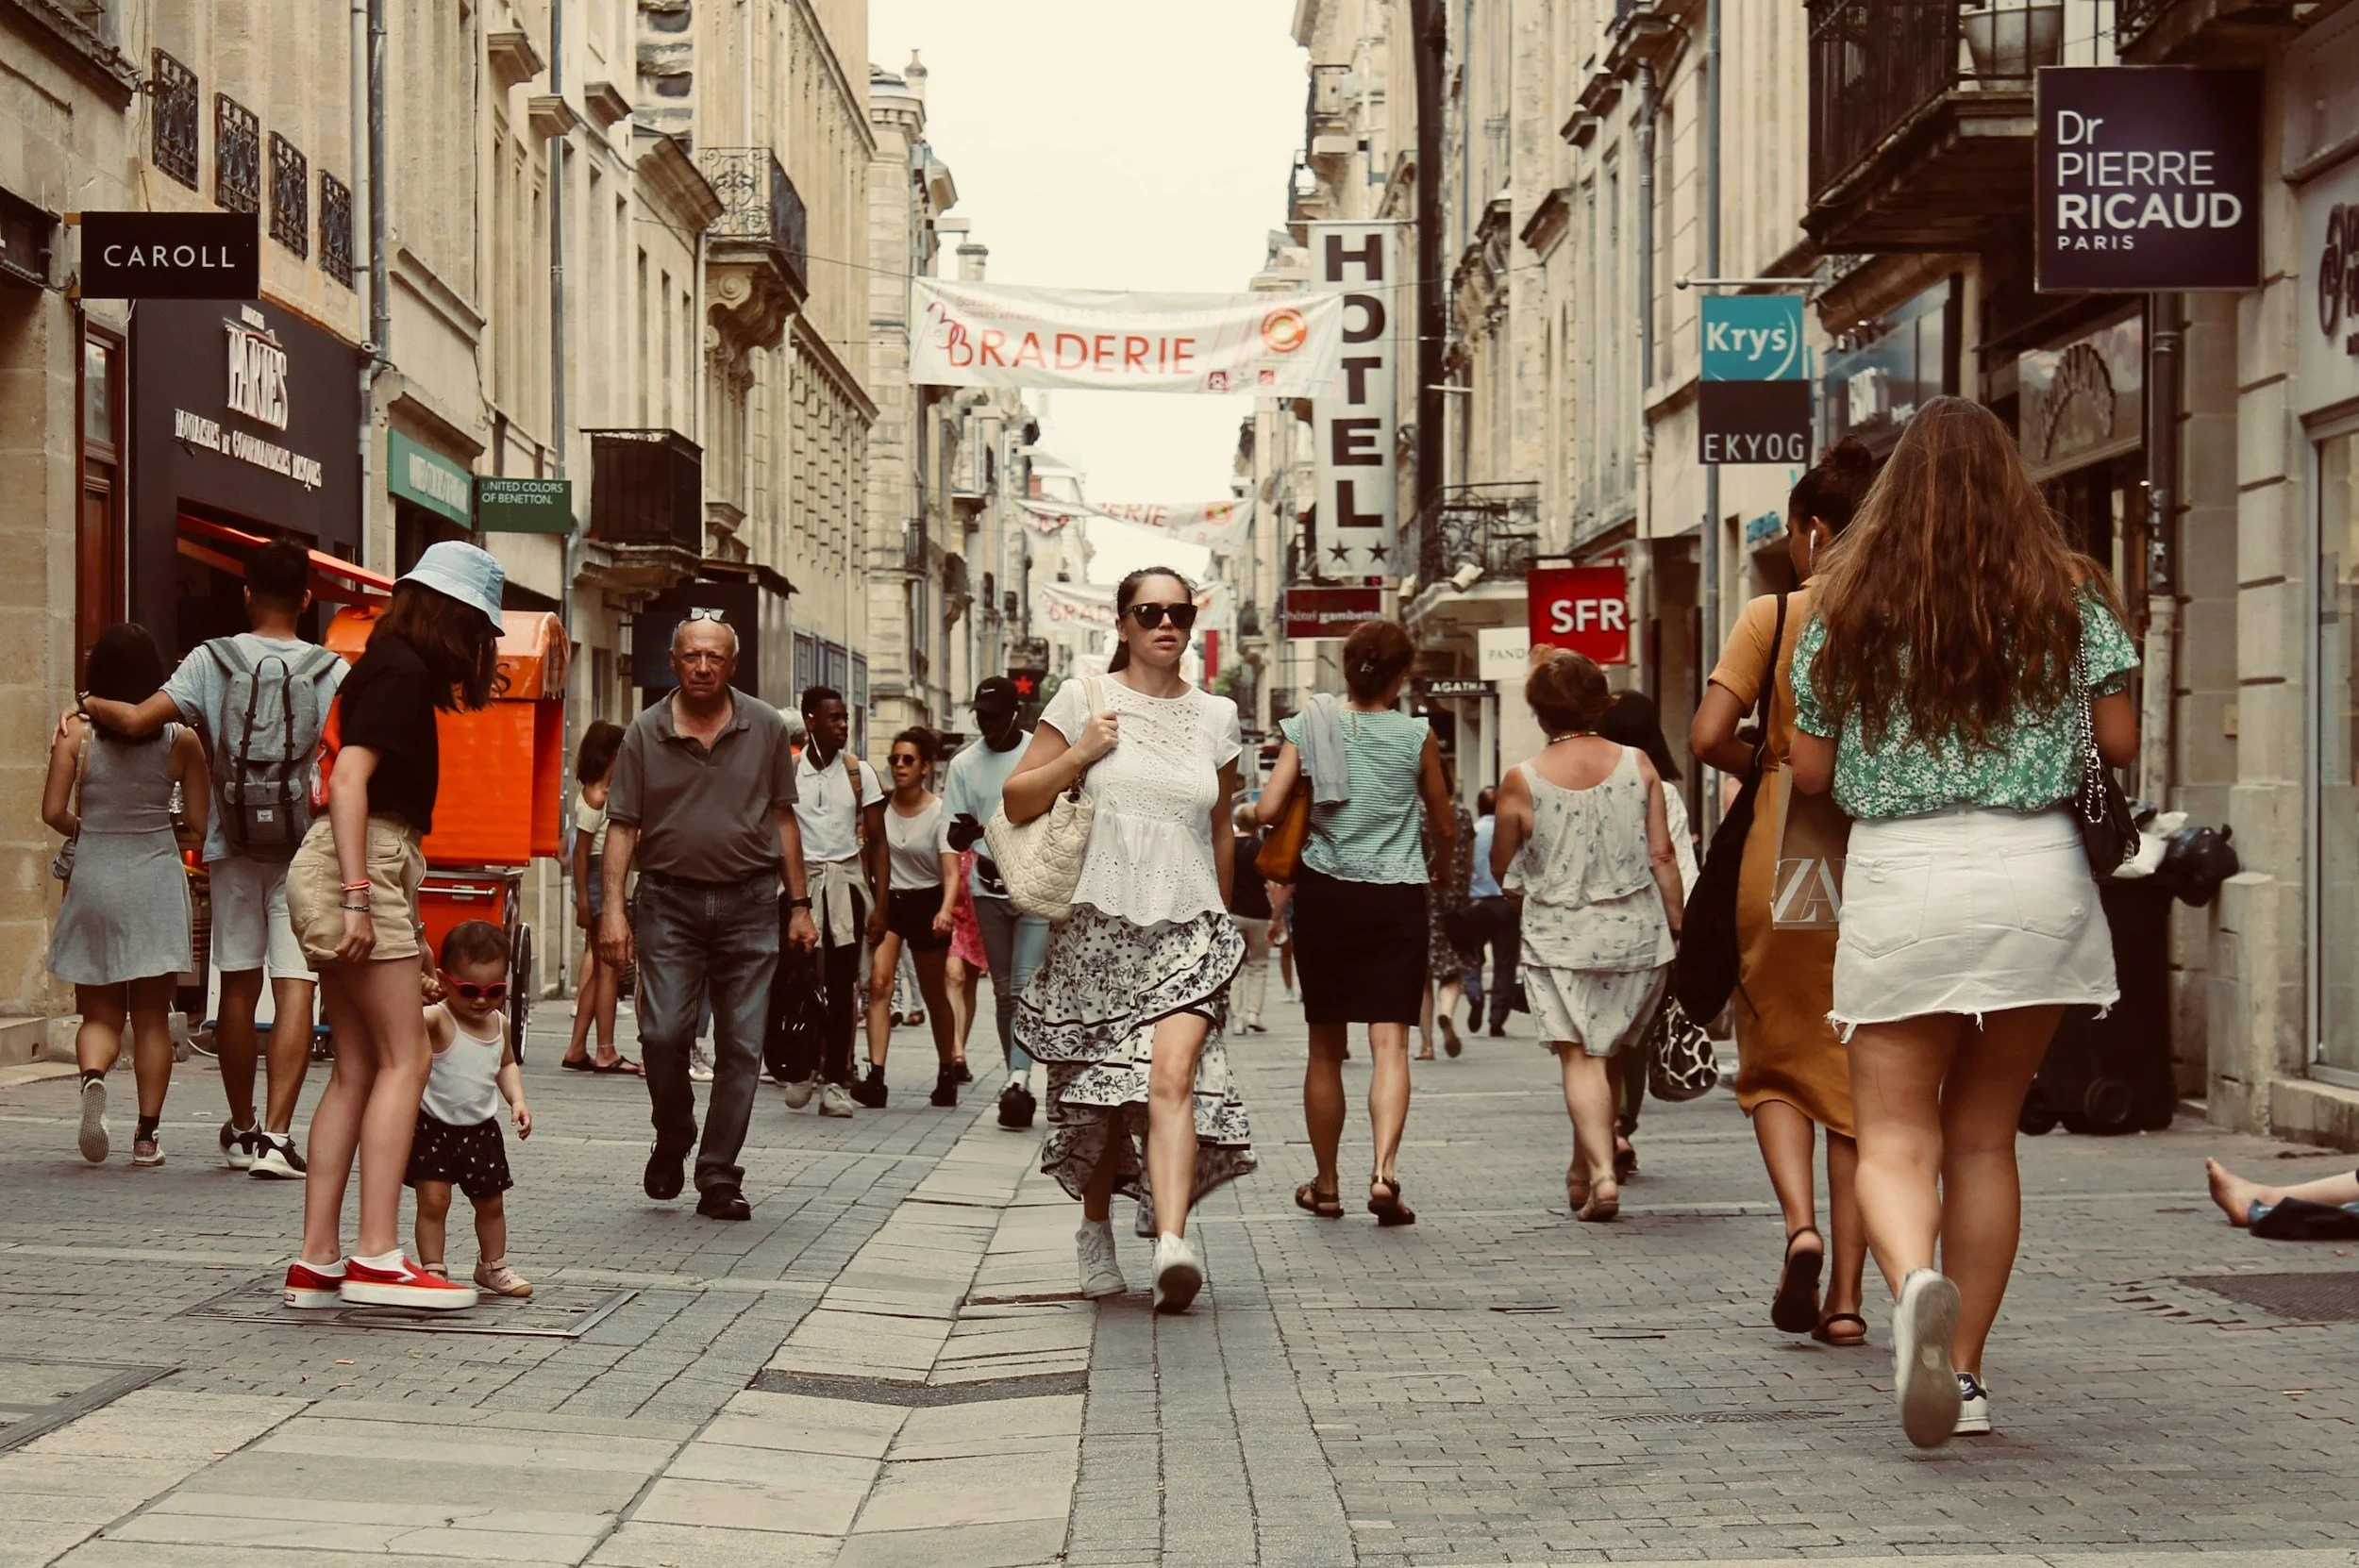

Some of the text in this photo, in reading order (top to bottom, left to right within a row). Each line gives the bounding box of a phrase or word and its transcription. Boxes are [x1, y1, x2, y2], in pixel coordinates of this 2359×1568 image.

[2057, 110, 2103, 144] Dr
[2057, 151, 2216, 186] PIERRE
[2057, 193, 2243, 228] RICAUD
[2057, 235, 2135, 250] PARIS
[104, 245, 236, 268] CAROLL
[944, 319, 1196, 375] BRADERIE
[1706, 322, 1787, 361] Krys
[1325, 233, 1386, 529] HOTEL
[1705, 434, 1804, 461] EKYOG
[482, 493, 496, 503] OF
[522, 482, 563, 492] COLORS
[1102, 502, 1168, 527] ERIE
[1047, 600, 1114, 623] BRAD
[1550, 598, 1626, 634] SFR
[1488, 648, 1529, 660] PAND
[1431, 681, 1487, 693] AGATHA
[1774, 857, 1847, 923] ZA
